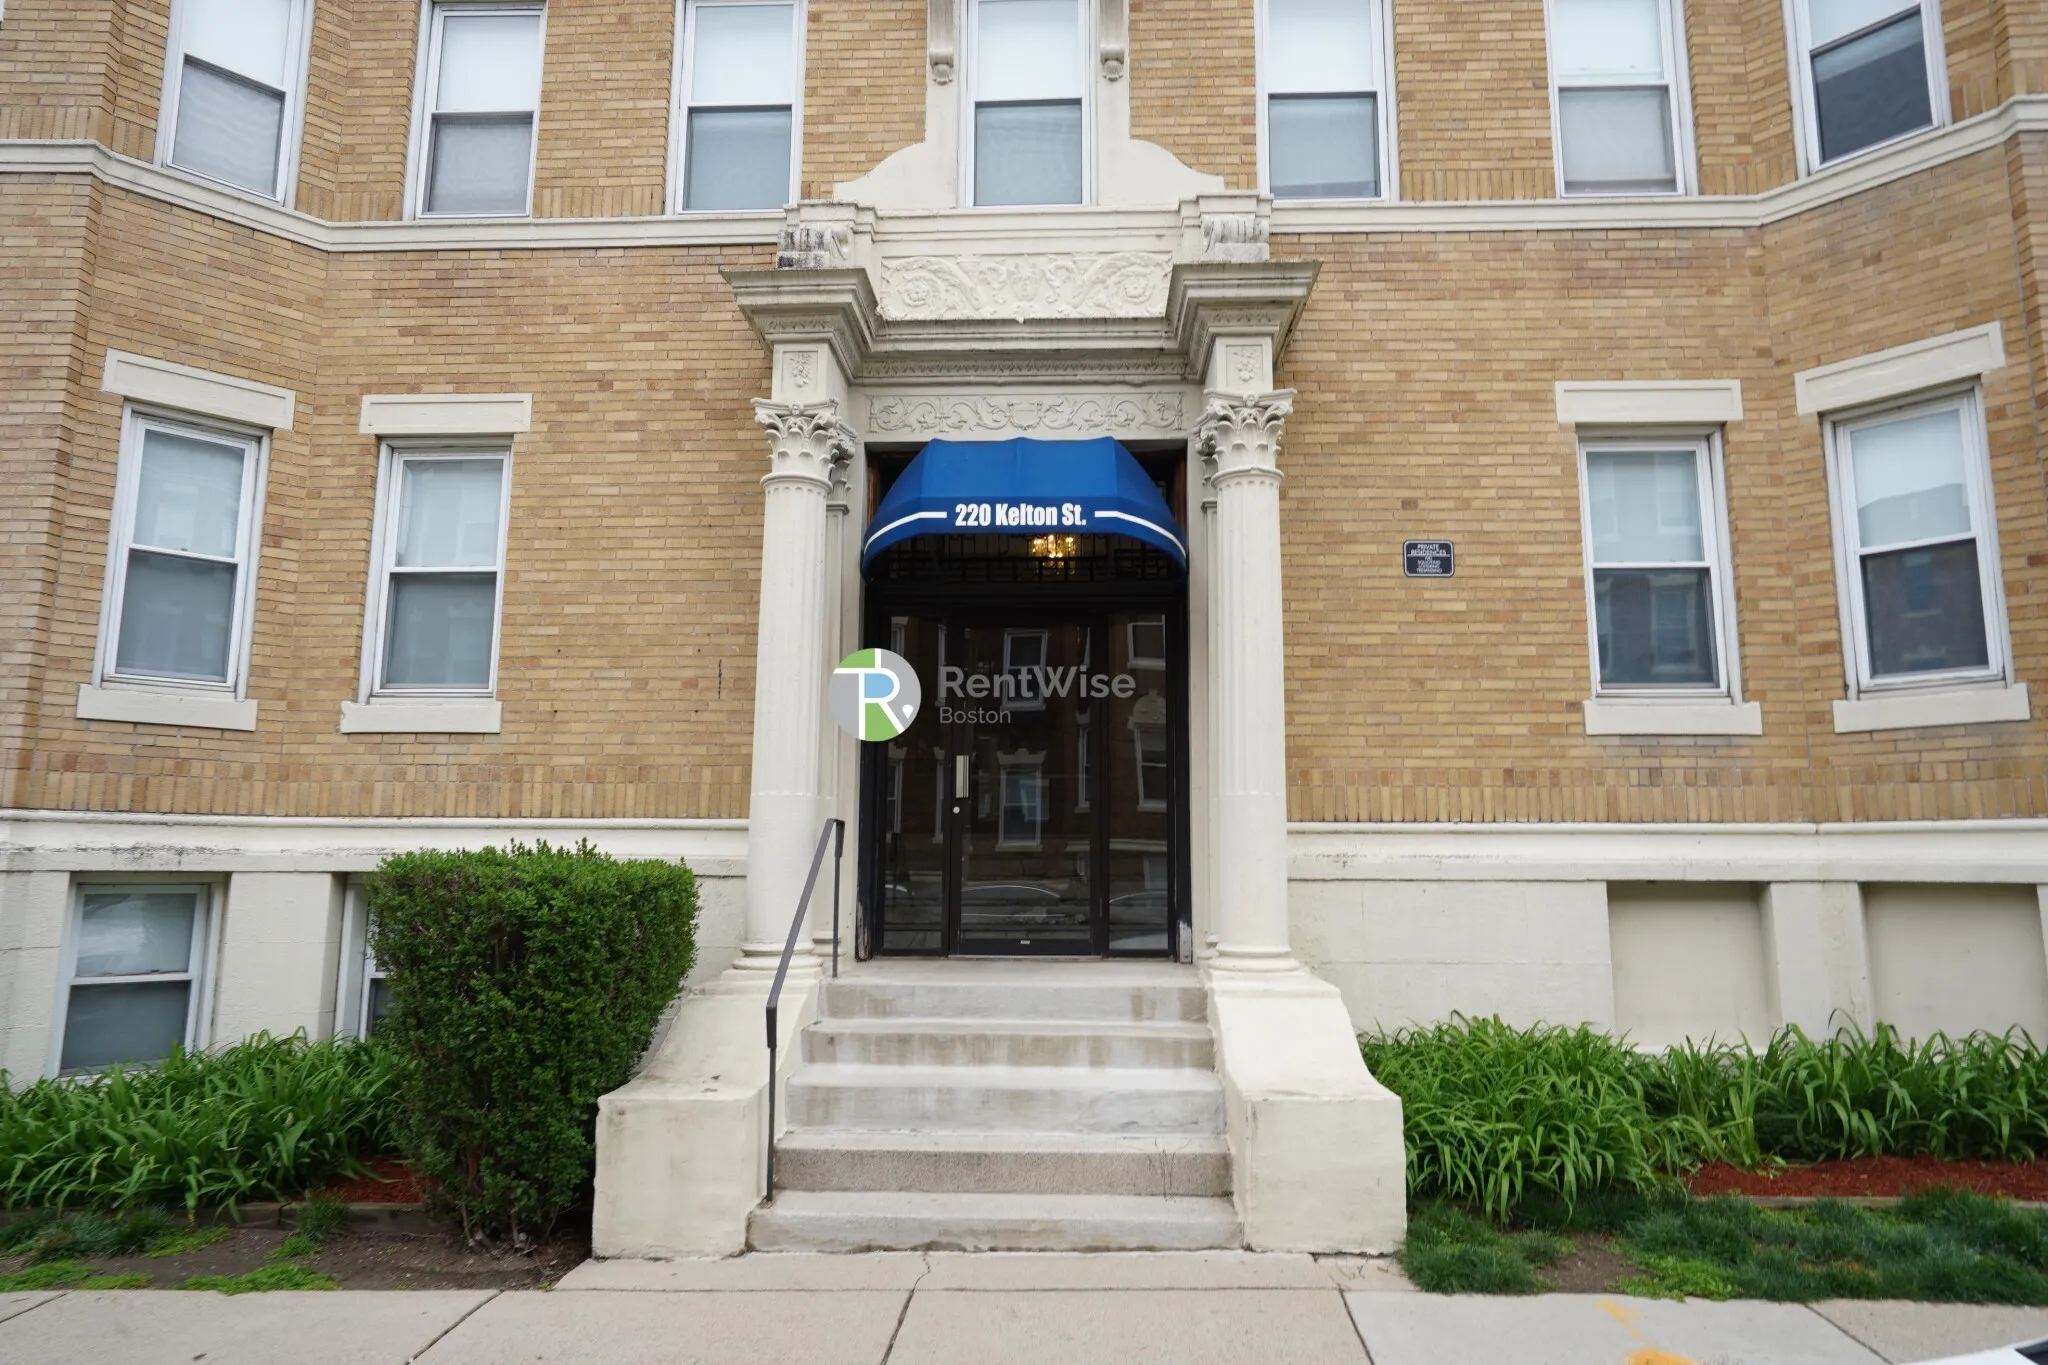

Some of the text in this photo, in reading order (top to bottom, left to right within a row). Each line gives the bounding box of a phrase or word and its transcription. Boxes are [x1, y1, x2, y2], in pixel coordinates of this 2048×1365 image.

[955, 502, 1087, 526] 220 Kelton St.
